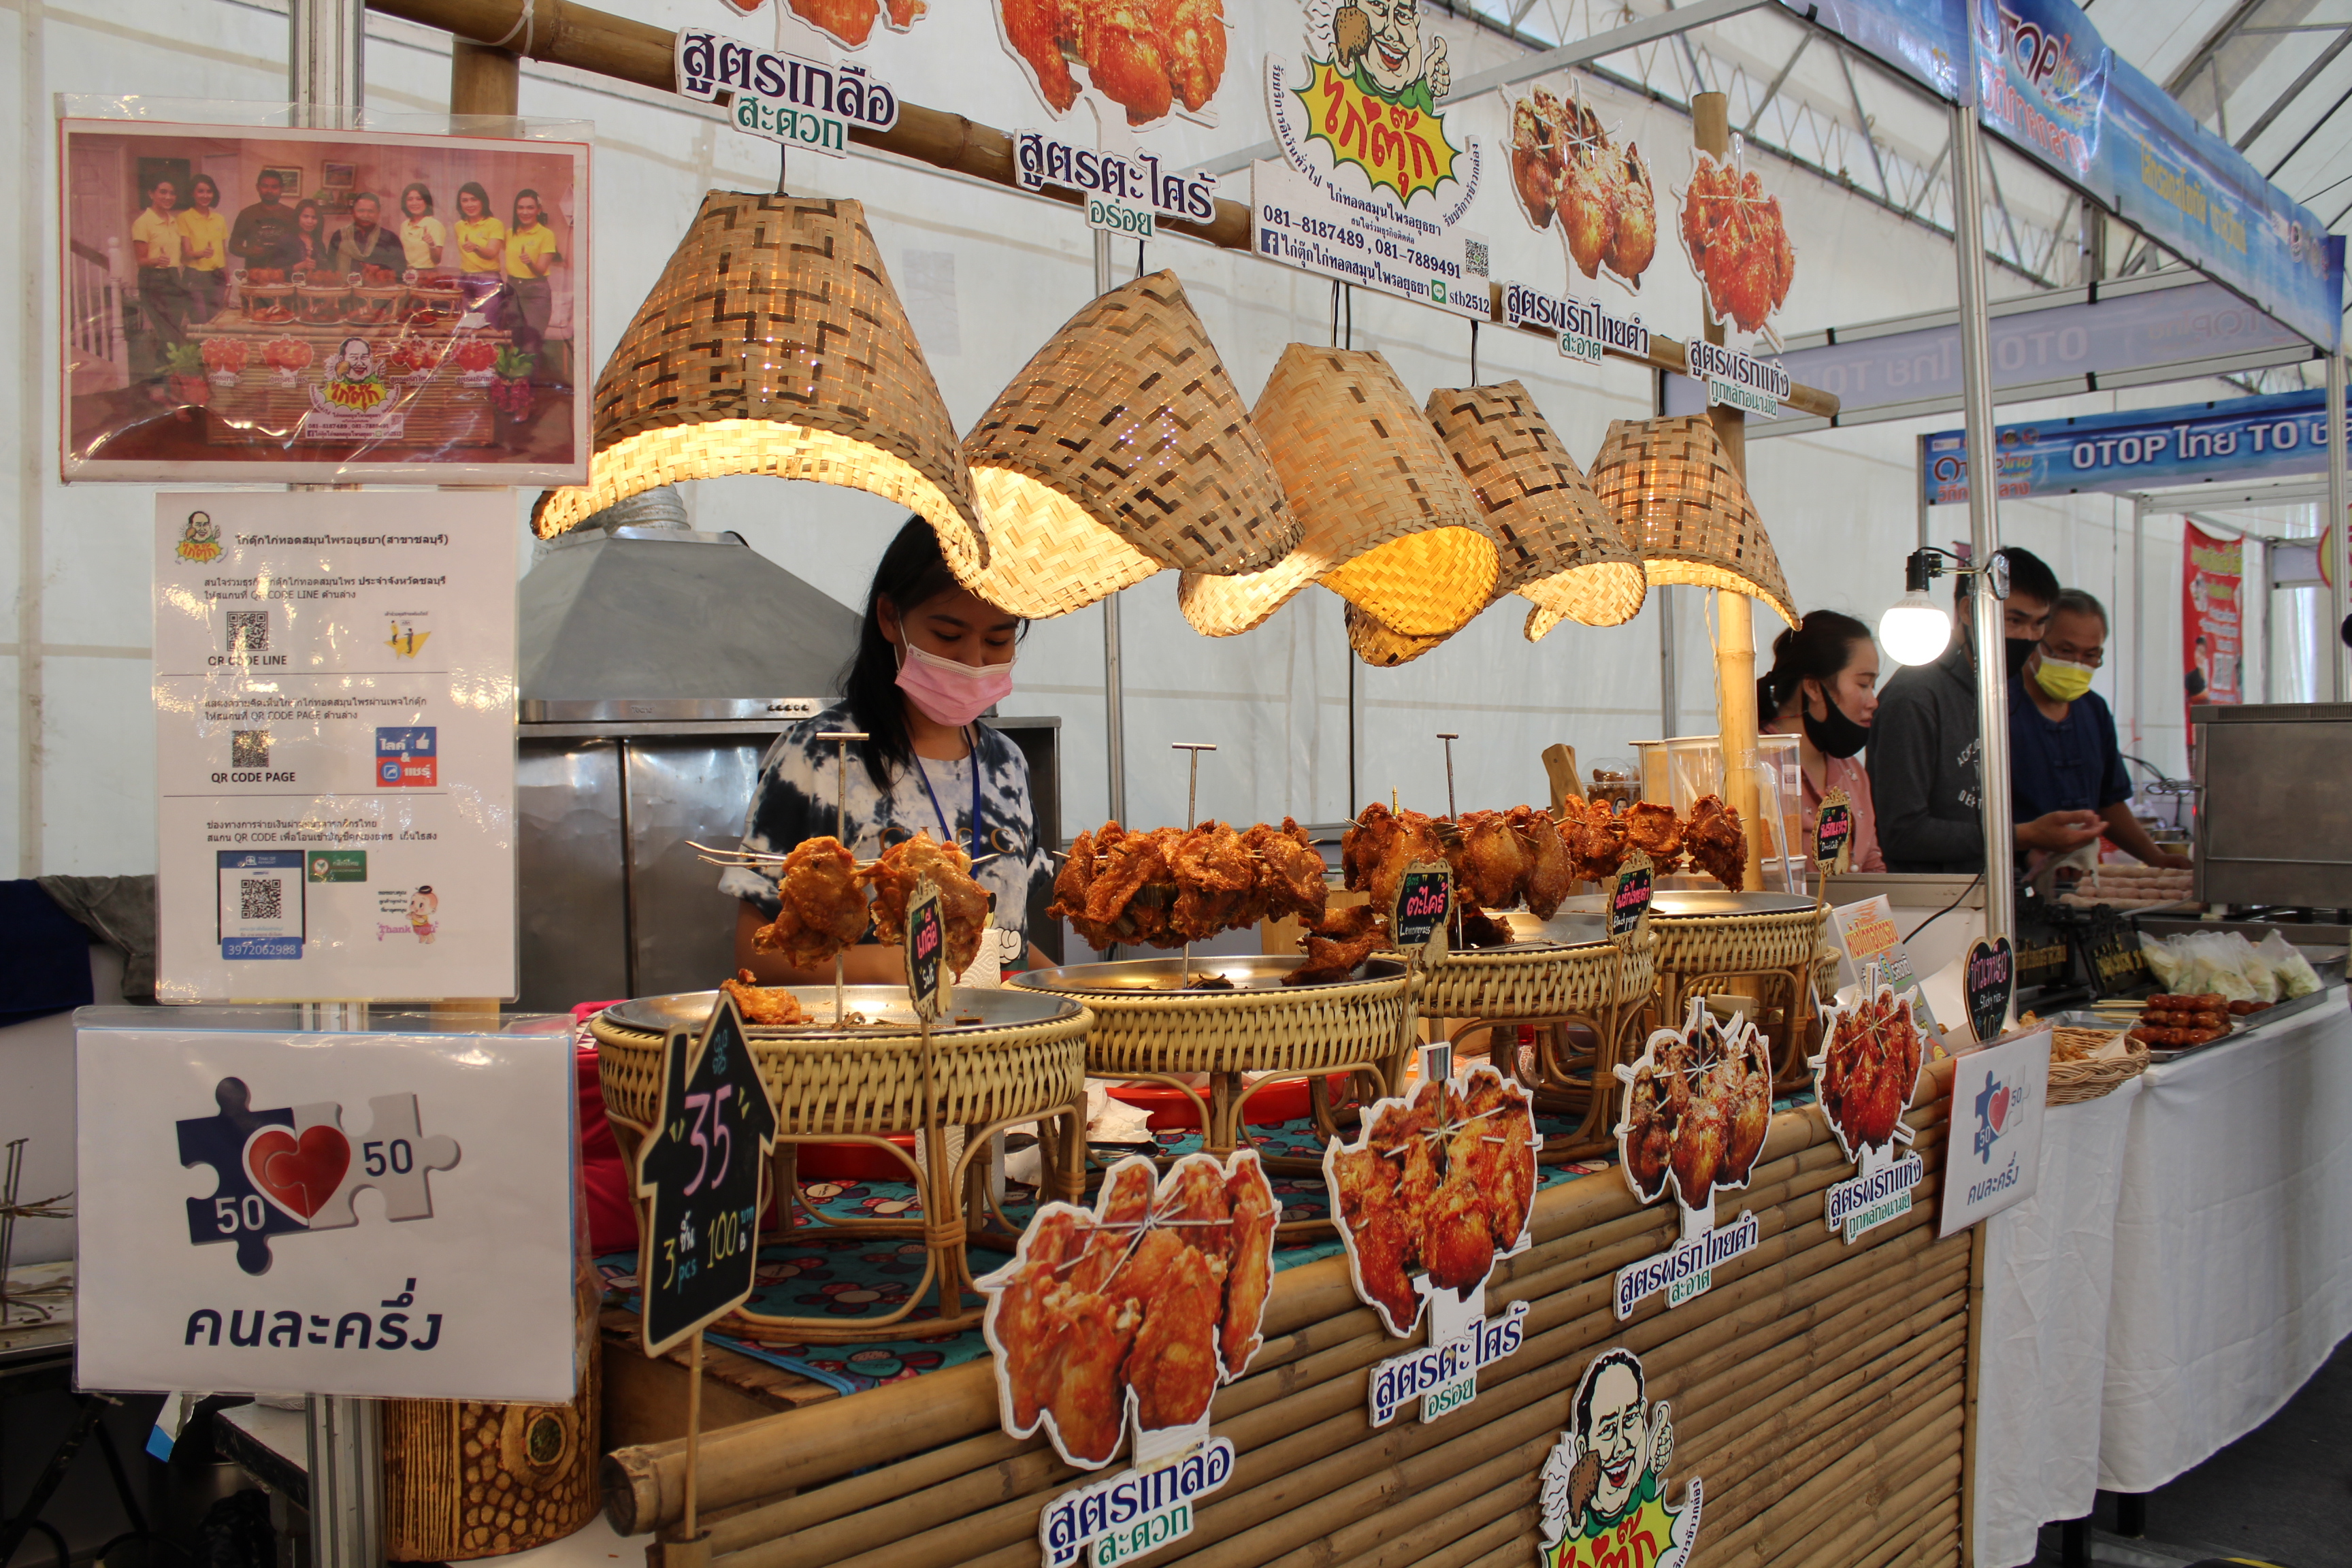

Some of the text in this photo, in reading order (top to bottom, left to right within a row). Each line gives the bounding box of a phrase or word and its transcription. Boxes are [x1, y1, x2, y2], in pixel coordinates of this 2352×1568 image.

[683, 33, 895, 126] สูตรเกลือ
[738, 95, 843, 150] สะดวก
[1324, 67, 1438, 197] ไก่ตุ๊ก
[1019, 133, 1216, 219] สูตรตะไคร้
[1090, 199, 1152, 238] อร่อย
[1327, 182, 1441, 236] ไก่ทอดสมุนไพรอยุธยา
[1264, 204, 1460, 280] 081-8187489 081-7889491
[1351, 216, 1415, 245] สนใจร่วมธุรกิจติดต่อ
[1281, 233, 1429, 298] ไก่ตุ๊กไก่ทอดสมุนไพรอยุธยา
[1507, 284, 1649, 355] สูตรพริกไทยดำ
[1562, 333, 1601, 361] สะอาด
[1690, 340, 1789, 397] สูตรพริกแห้ง
[1712, 380, 1777, 416] ถูกหลักอนามัย
[2072, 434, 2167, 470] OTOP
[2174, 424, 2237, 459] ไทย
[2248, 421, 2298, 452] TO
[297, 590, 318, 599] LINE
[322, 589, 356, 600] ด้านล่าง
[208, 656, 225, 666] QR
[263, 655, 287, 665] LINE
[250, 713, 264, 721] QR
[267, 713, 293, 721] CODE
[297, 712, 321, 720] PAGE
[324, 710, 357, 721] ด้านล่าง
[400, 752, 411, 762] &
[211, 772, 295, 783] QR CODE PAGE
[207, 833, 231, 843] สแกน
[235, 833, 248, 843] QR
[251, 833, 277, 842] CODE
[1407, 882, 1448, 917] ตะไคร้
[378, 925, 411, 933] Thank
[917, 907, 937, 960] เกลือ
[228, 945, 296, 956] 3972062988
[923, 963, 934, 990] Salt
[2012, 1087, 2022, 1107] 50
[684, 1085, 731, 1196] 35
[1980, 1126, 1991, 1147] 50
[363, 1139, 412, 1177] 50
[1967, 1151, 2019, 1205] คนละครึ่ง
[1831, 1154, 1921, 1227] สูตรพริกแห้ง
[215, 1195, 265, 1234] 50
[1849, 1190, 1910, 1239] ถูกหลักอนามัย
[663, 1239, 675, 1290] 3
[708, 1211, 737, 1269] 100
[1620, 1215, 1757, 1315] สูตรพริกไทยดำ
[679, 1258, 696, 1296] pcs
[1671, 1269, 1710, 1303] สะอาด
[184, 1277, 443, 1351] คนละครึ่ง
[1376, 1306, 1526, 1422] สูตรตะไคร้
[1428, 1377, 1474, 1417] อร่อย
[1098, 1505, 1189, 1565] สะดวก
